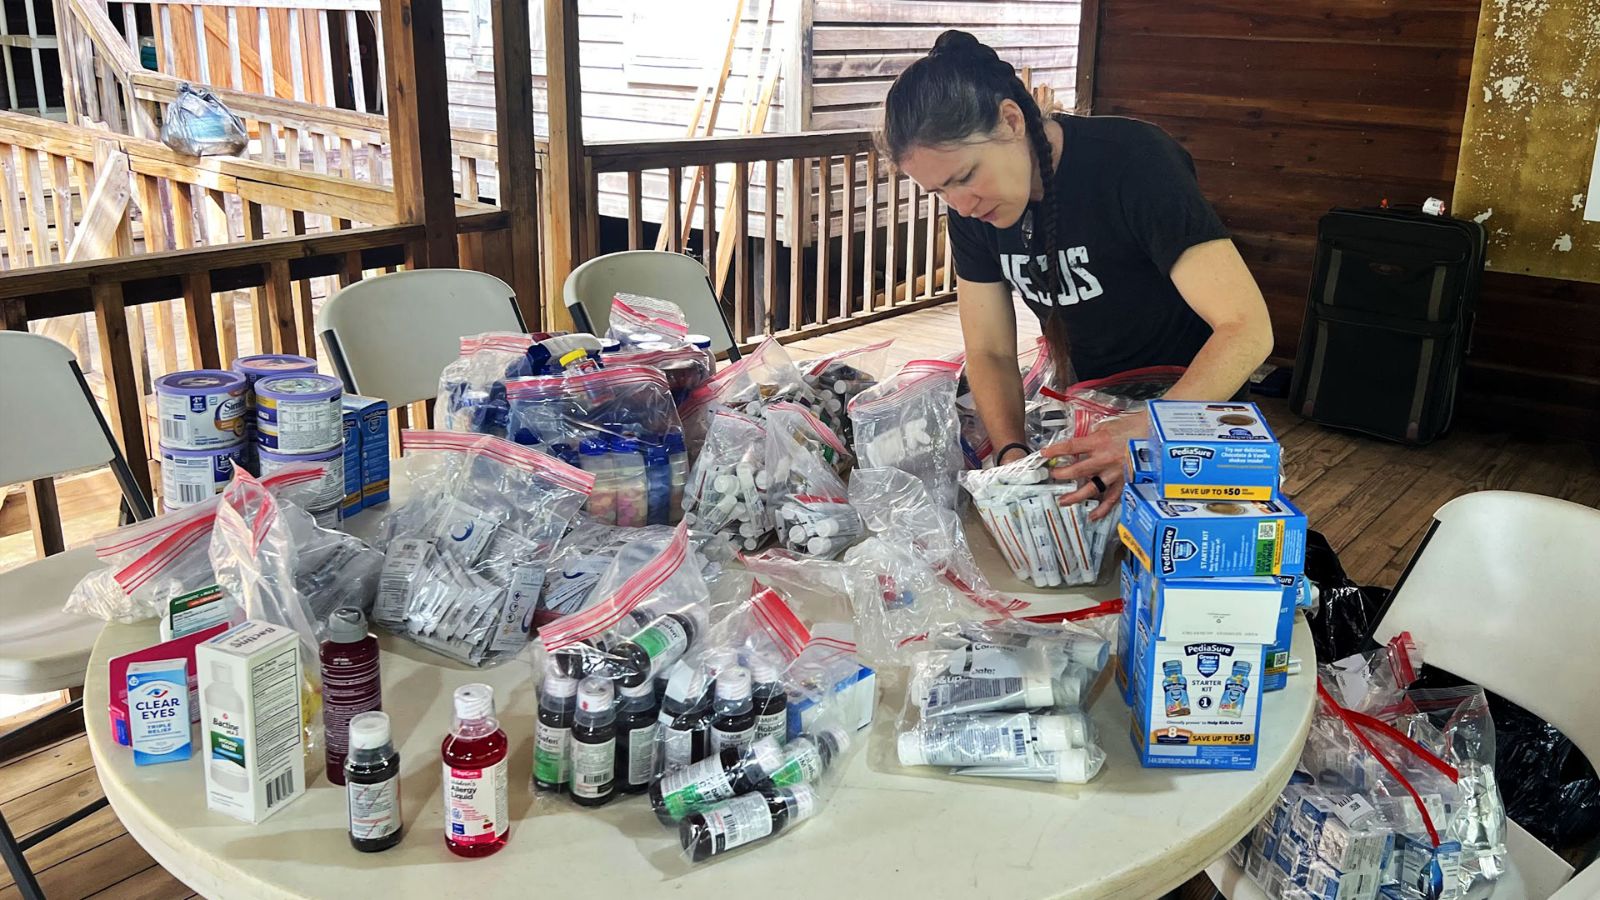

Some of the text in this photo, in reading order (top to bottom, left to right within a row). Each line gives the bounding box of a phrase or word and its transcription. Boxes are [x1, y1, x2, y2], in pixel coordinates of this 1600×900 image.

[1171, 448, 1212, 457] PediaSure
[1161, 529, 1174, 572] PediaSure
[1200, 542, 1208, 569] STARTER
[1187, 644, 1231, 654] PediaSure
[135, 698, 180, 710] CLEAR
[142, 708, 175, 720] EYES
[213, 717, 239, 732] Bactine
[1167, 726, 1178, 738] 8
[451, 785, 477, 794] Allergy
[451, 791, 474, 800] Liquid
